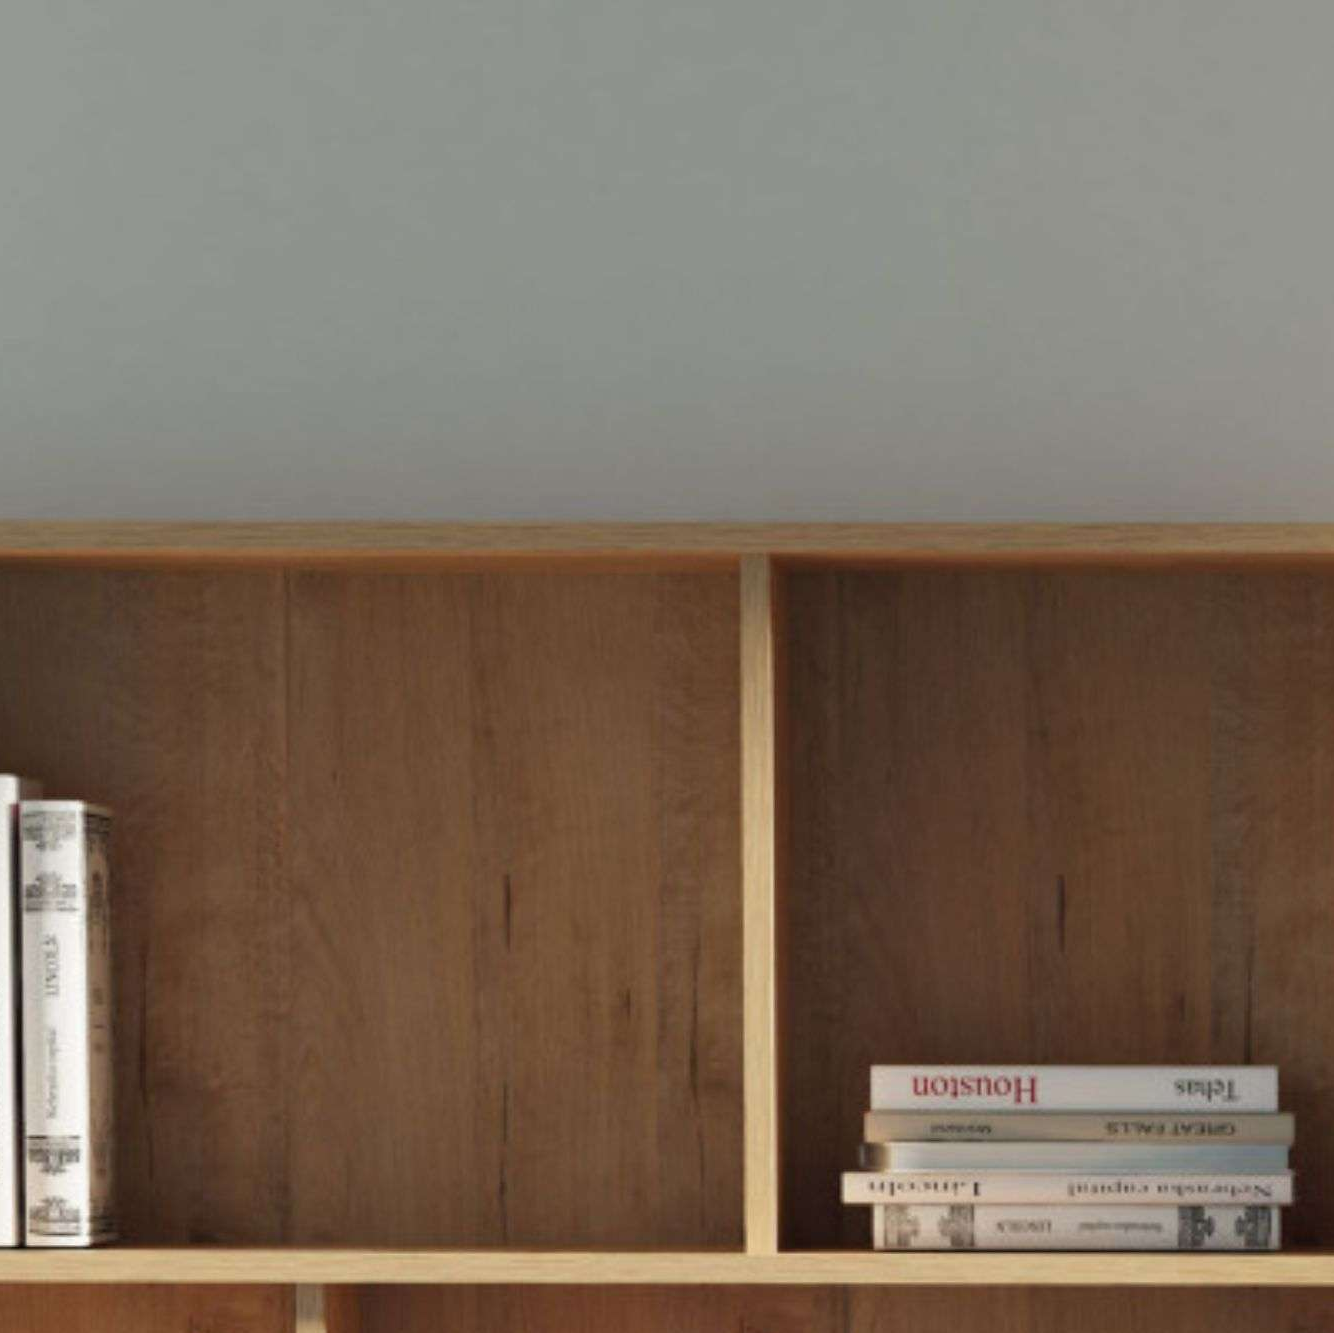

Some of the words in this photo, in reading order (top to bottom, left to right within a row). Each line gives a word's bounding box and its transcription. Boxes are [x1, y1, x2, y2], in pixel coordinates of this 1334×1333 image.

[911, 1074, 1038, 1104] Houston
[1105, 1120, 1167, 1137] FALLS
[1171, 1120, 1237, 1137] GREAT
[869, 1181, 981, 1198] Lincoln
